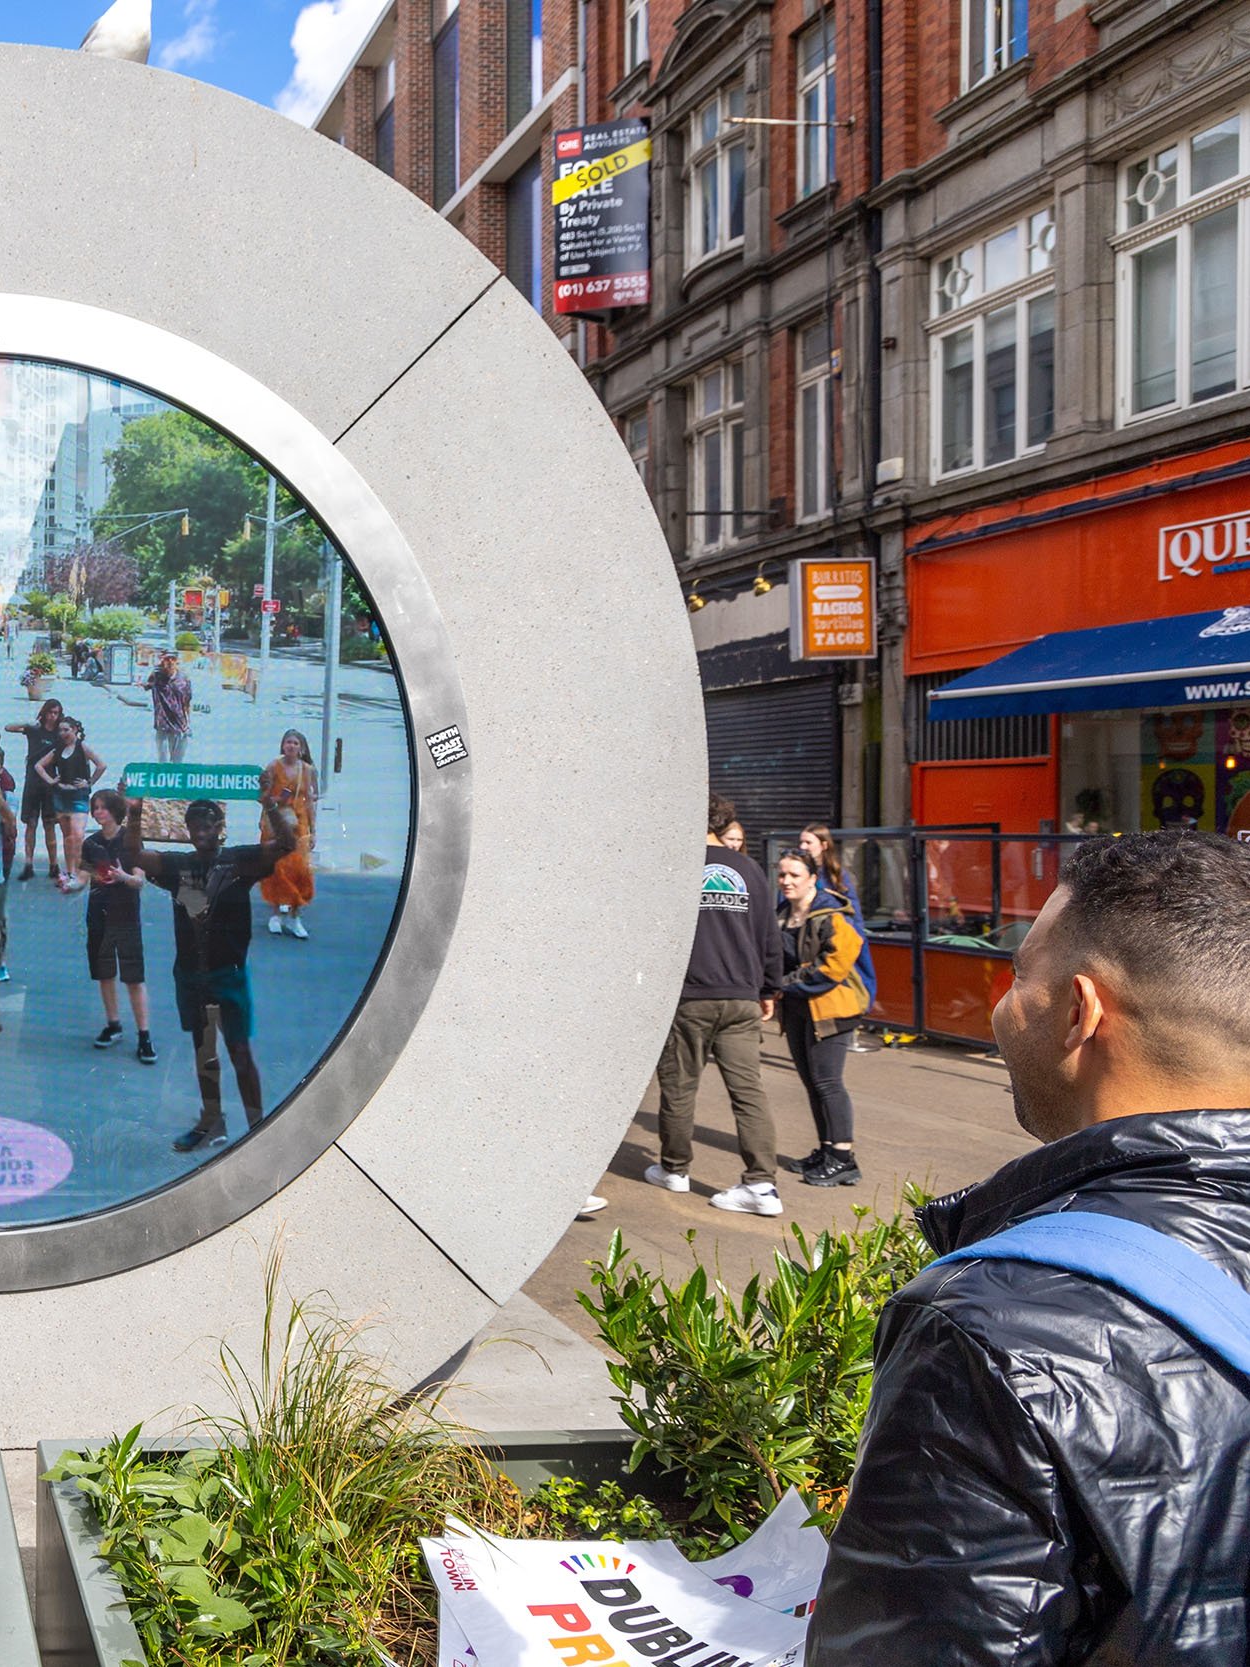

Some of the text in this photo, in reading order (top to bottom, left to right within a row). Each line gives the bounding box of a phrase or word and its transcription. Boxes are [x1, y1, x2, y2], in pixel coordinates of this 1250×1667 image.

[583, 126, 647, 142] REAL ESTATE
[583, 137, 631, 151] ADVISERS
[576, 154, 628, 188] SOLD
[559, 197, 624, 217] By Private
[559, 214, 601, 229] Treaty
[559, 240, 592, 251] Suitable
[613, 234, 642, 244] Variety
[560, 231, 576, 241] 483
[559, 252, 570, 262] of
[570, 251, 586, 260] Use
[586, 247, 616, 258] Subject
[558, 275, 647, 299] (01) 637 5555
[613, 288, 646, 302] qre.ie
[812, 570, 864, 585] BURRITOS
[812, 601, 864, 616] NACHOS
[813, 631, 865, 646] TACOS
[426, 726, 459, 747] NORTH
[431, 736, 461, 755] COAST
[125, 771, 261, 791] WE LOVE DUBLINERS
[701, 893, 749, 907] OMADIC
[440, 1548, 466, 1591] TOWN
[527, 1603, 630, 1667] PR
